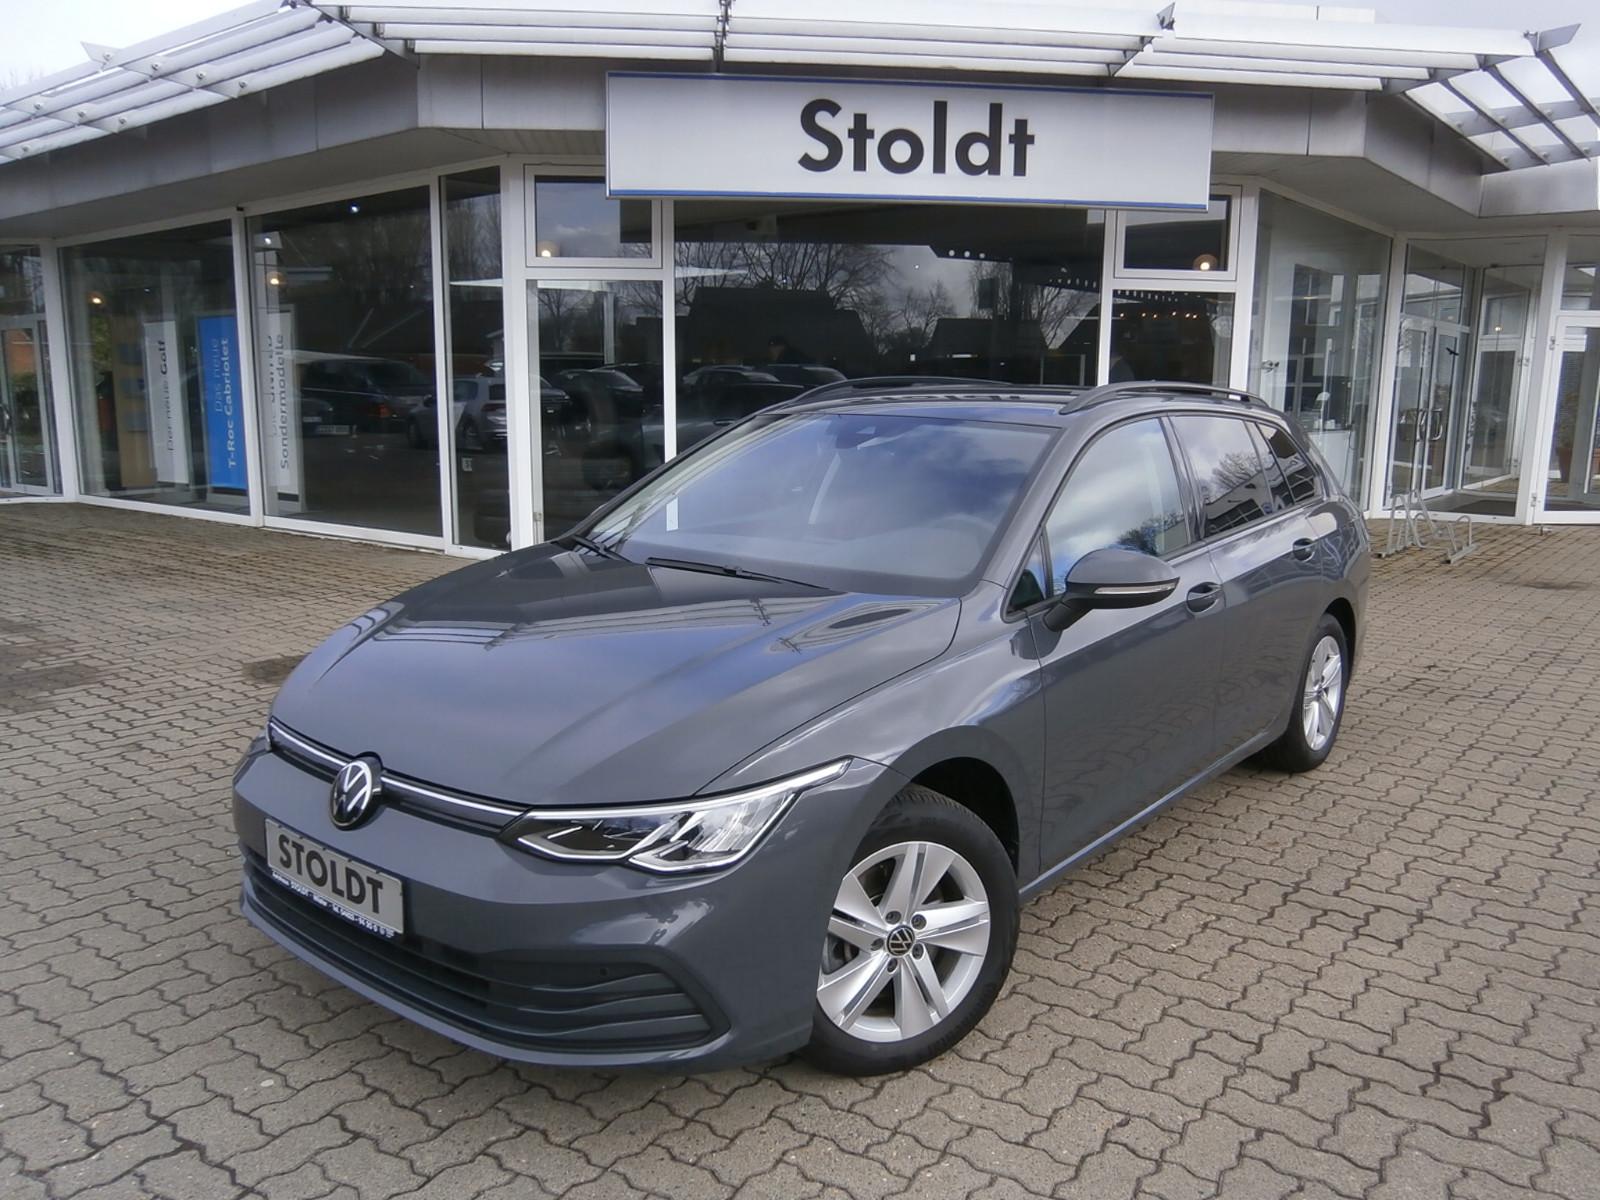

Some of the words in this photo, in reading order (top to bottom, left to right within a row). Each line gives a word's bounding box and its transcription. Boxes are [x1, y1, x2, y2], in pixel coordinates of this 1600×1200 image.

[798, 98, 1035, 176] Stoldt
[158, 341, 168, 374] Golf
[221, 337, 233, 416] Cabriolet
[214, 383, 222, 412] Das
[275, 334, 289, 470] Sondermodelle
[226, 420, 237, 469] T-Roc
[279, 834, 383, 913] STOLDT
